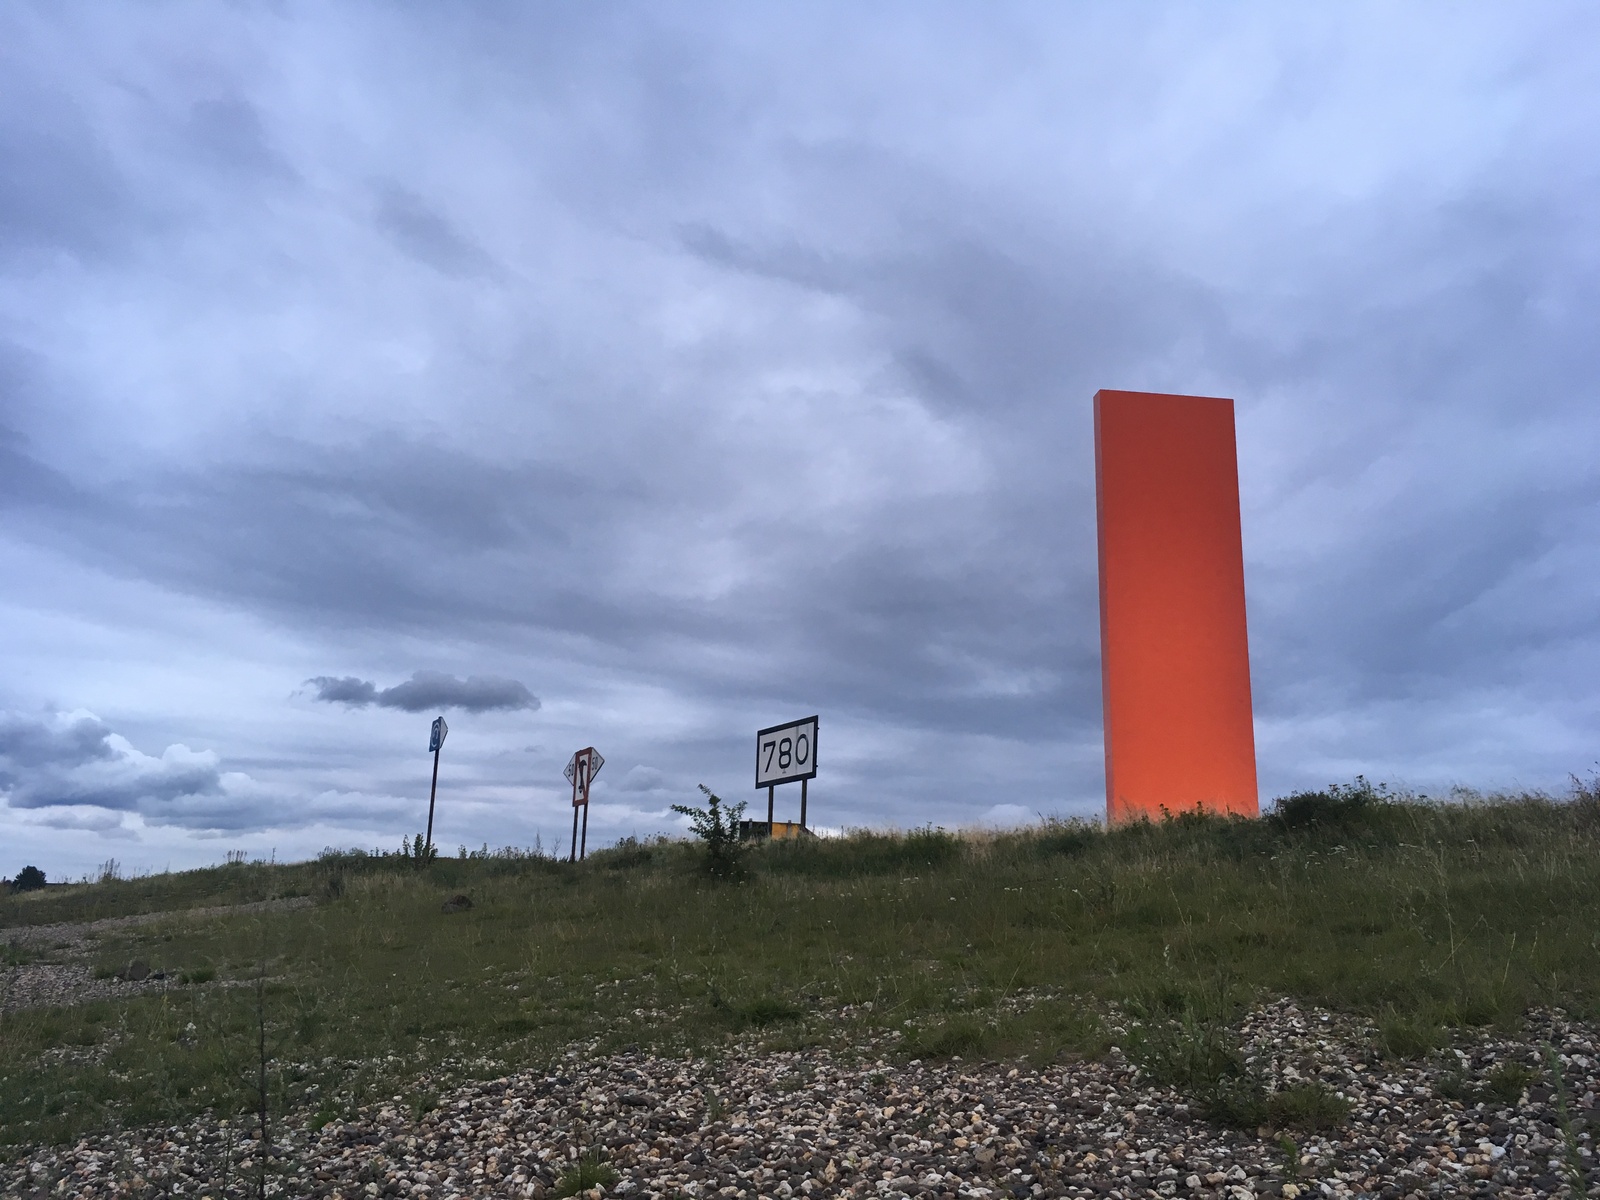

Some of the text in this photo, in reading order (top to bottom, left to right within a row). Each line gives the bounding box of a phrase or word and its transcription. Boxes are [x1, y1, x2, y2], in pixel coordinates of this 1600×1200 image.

[763, 733, 809, 773] 780
[568, 763, 575, 777] 50
[591, 756, 599, 771] 50
